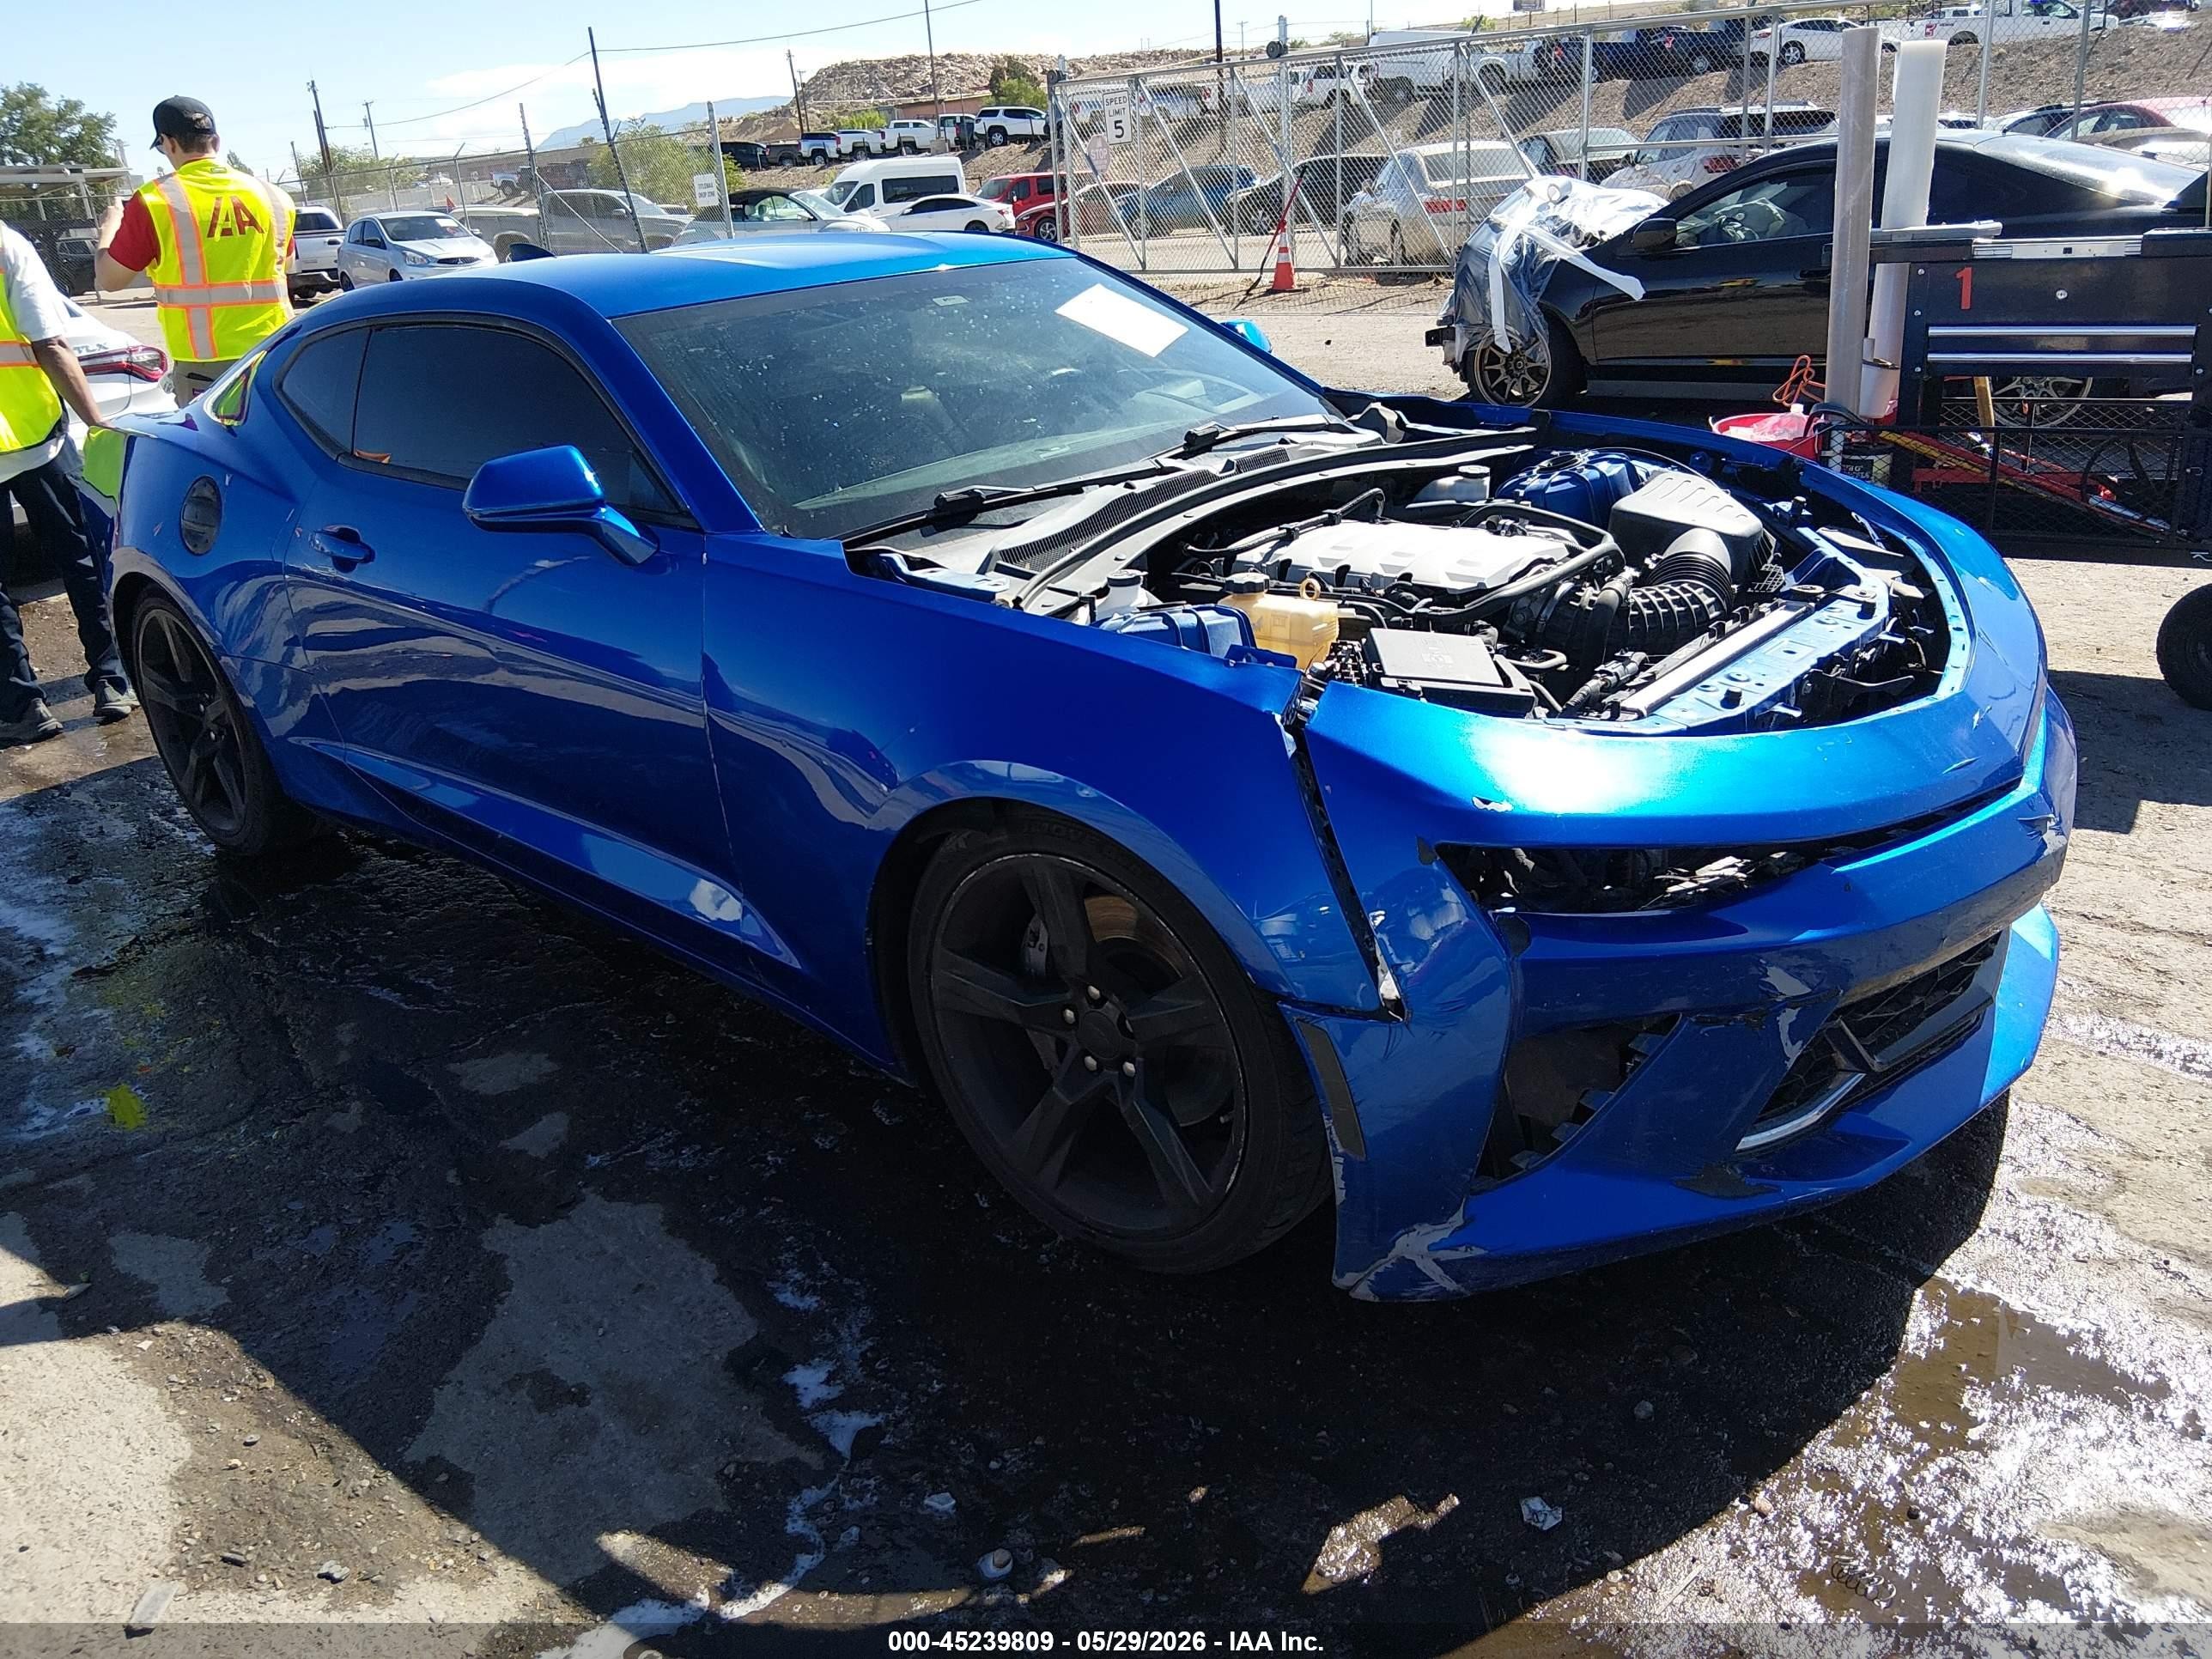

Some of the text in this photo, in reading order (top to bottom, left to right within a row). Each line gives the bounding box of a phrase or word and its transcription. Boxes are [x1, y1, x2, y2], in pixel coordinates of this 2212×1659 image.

[1105, 95, 1127, 106] SPEED
[1108, 107, 1126, 118] LIMIT
[1114, 119, 1125, 138] 5
[1091, 148, 1108, 160] STOP
[1955, 266, 1972, 310] 1
